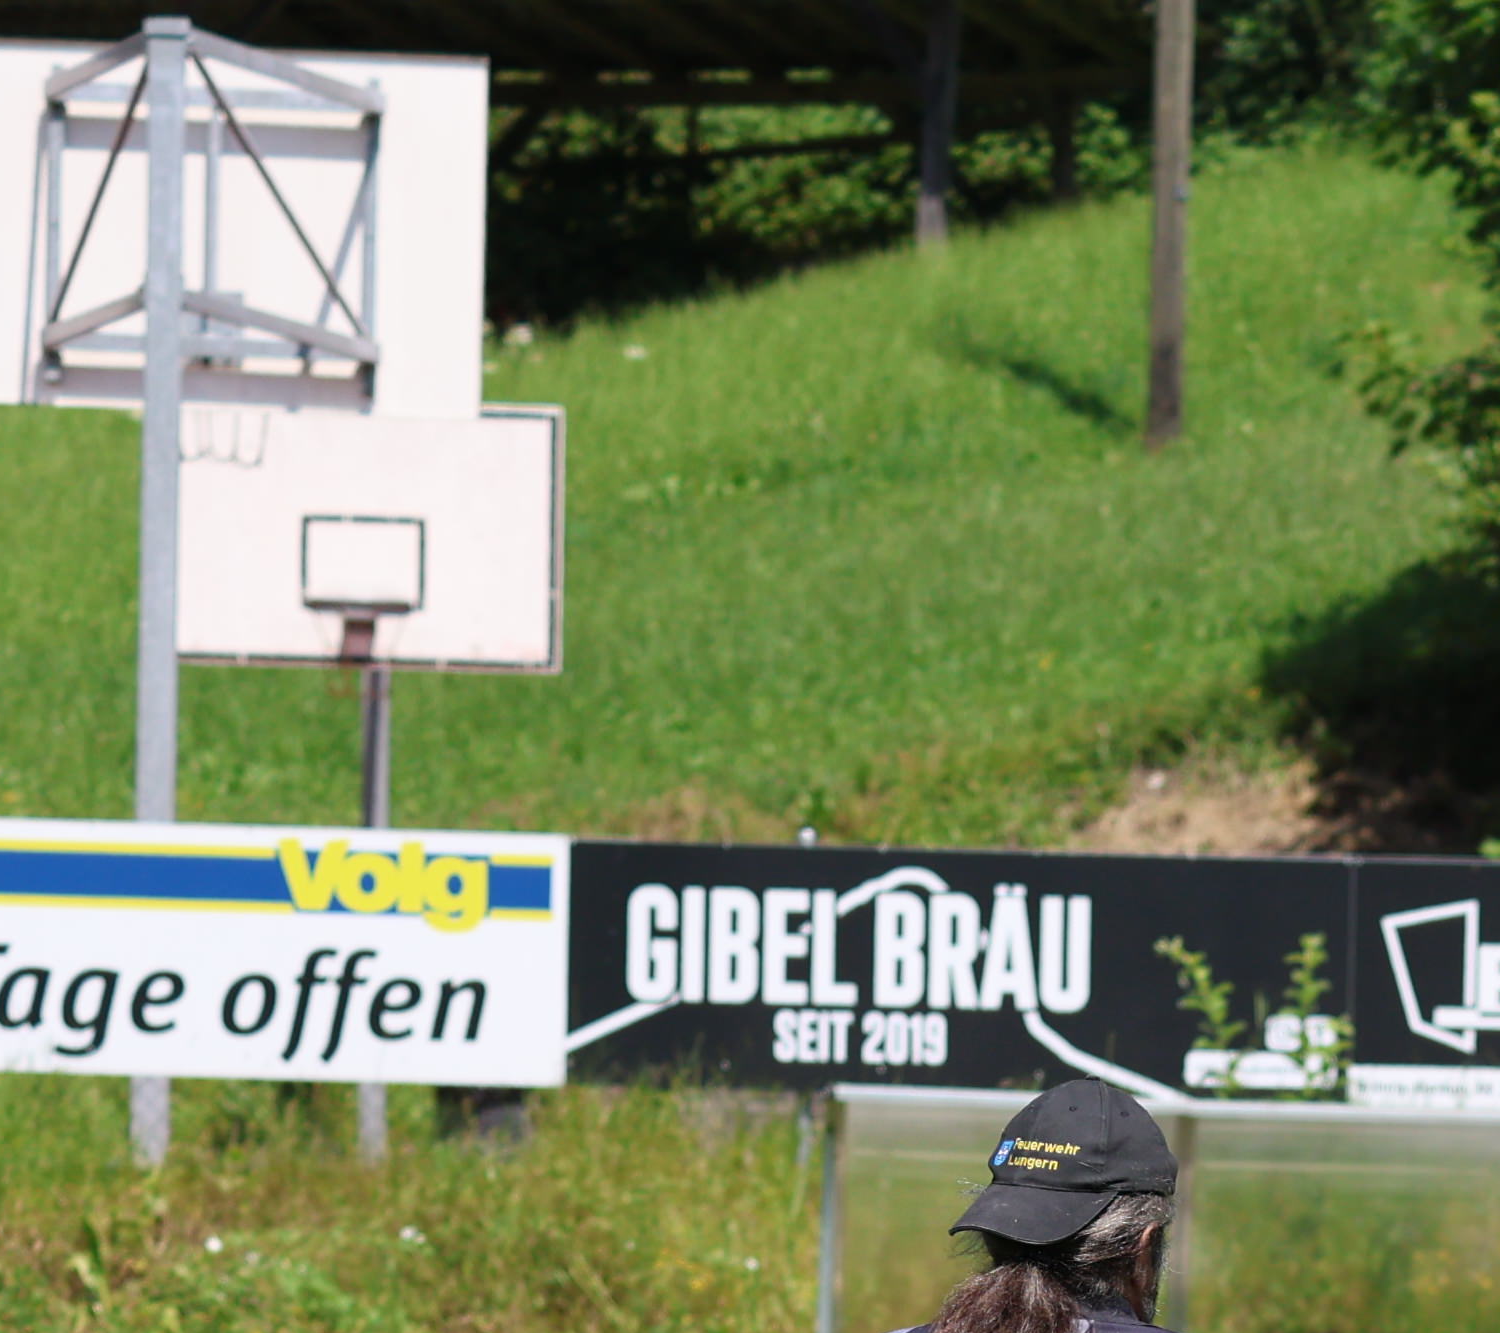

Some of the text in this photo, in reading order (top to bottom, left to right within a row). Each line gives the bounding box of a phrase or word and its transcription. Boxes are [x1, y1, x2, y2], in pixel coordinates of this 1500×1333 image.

[279, 838, 488, 932] Volg
[625, 882, 1092, 1014] GIBEL BRÄU
[221, 948, 489, 1063] offen
[772, 1009, 948, 1067] SEIT 2019
[1007, 1153, 1059, 1171] Lungern
[1013, 1137, 1081, 1157] Feuerwehr
